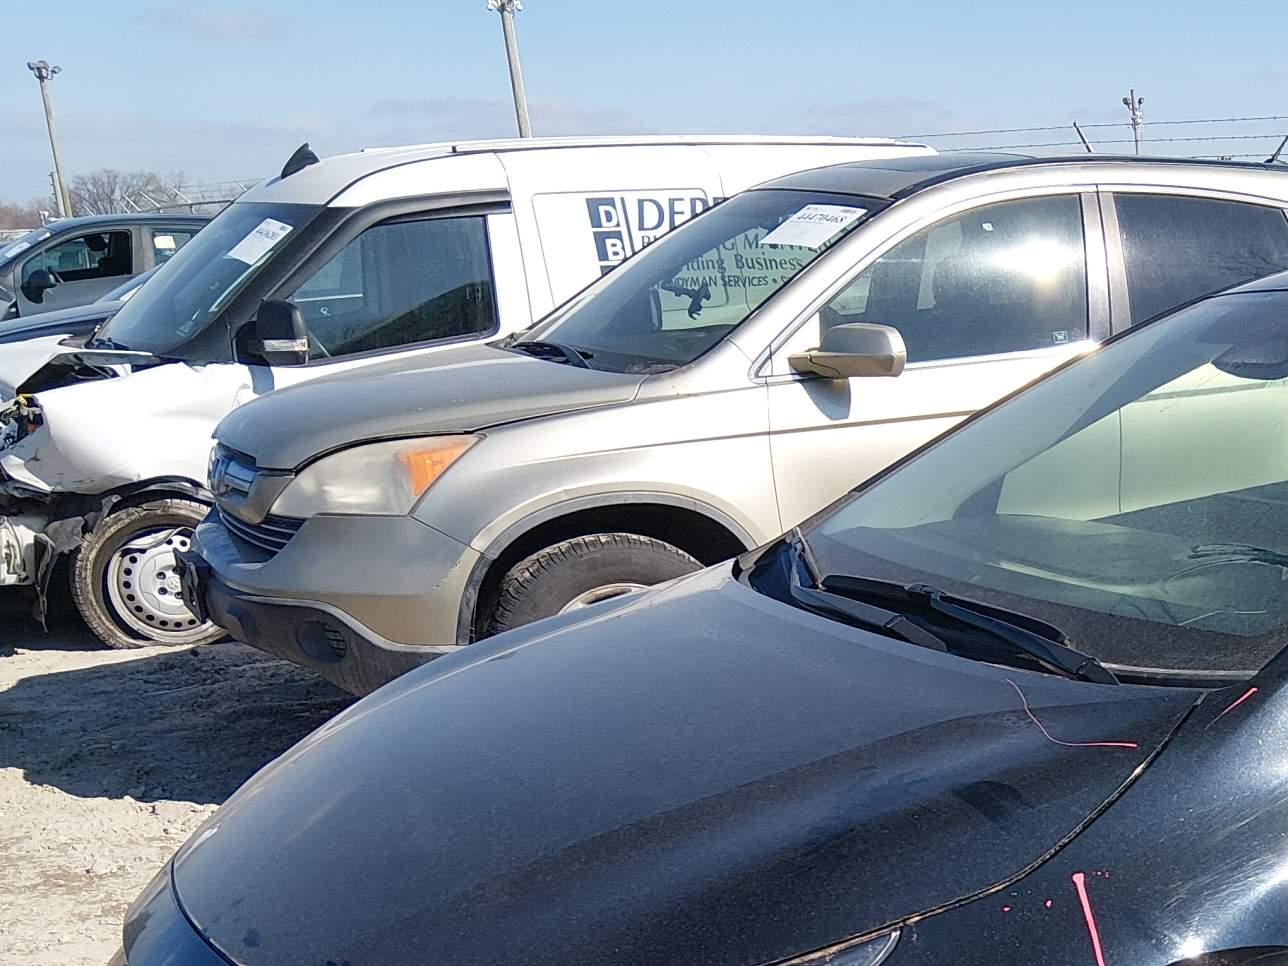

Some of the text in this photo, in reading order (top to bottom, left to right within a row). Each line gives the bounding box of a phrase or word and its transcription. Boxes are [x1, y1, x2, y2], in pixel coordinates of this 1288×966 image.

[598, 205, 620, 228] D
[604, 238, 626, 261] B
[720, 274, 769, 290] SERVICES
